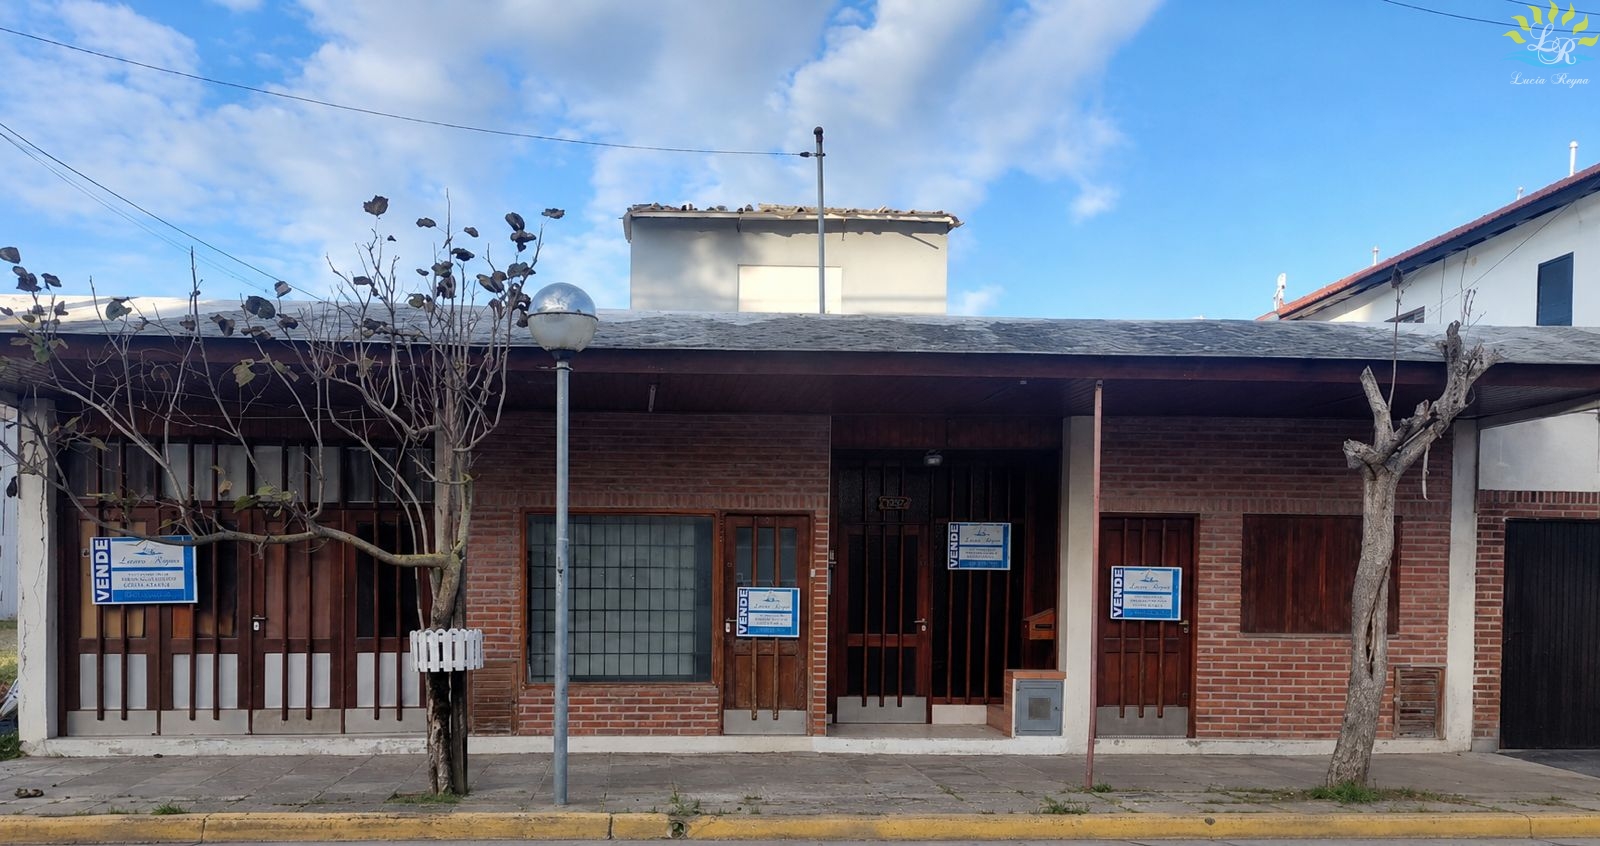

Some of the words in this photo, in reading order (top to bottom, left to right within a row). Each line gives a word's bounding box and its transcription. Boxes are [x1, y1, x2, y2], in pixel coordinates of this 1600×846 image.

[950, 524, 959, 568] VENDE
[95, 539, 110, 602] VENDE
[1113, 568, 1123, 617] VENDE
[739, 589, 748, 635] VENDE
